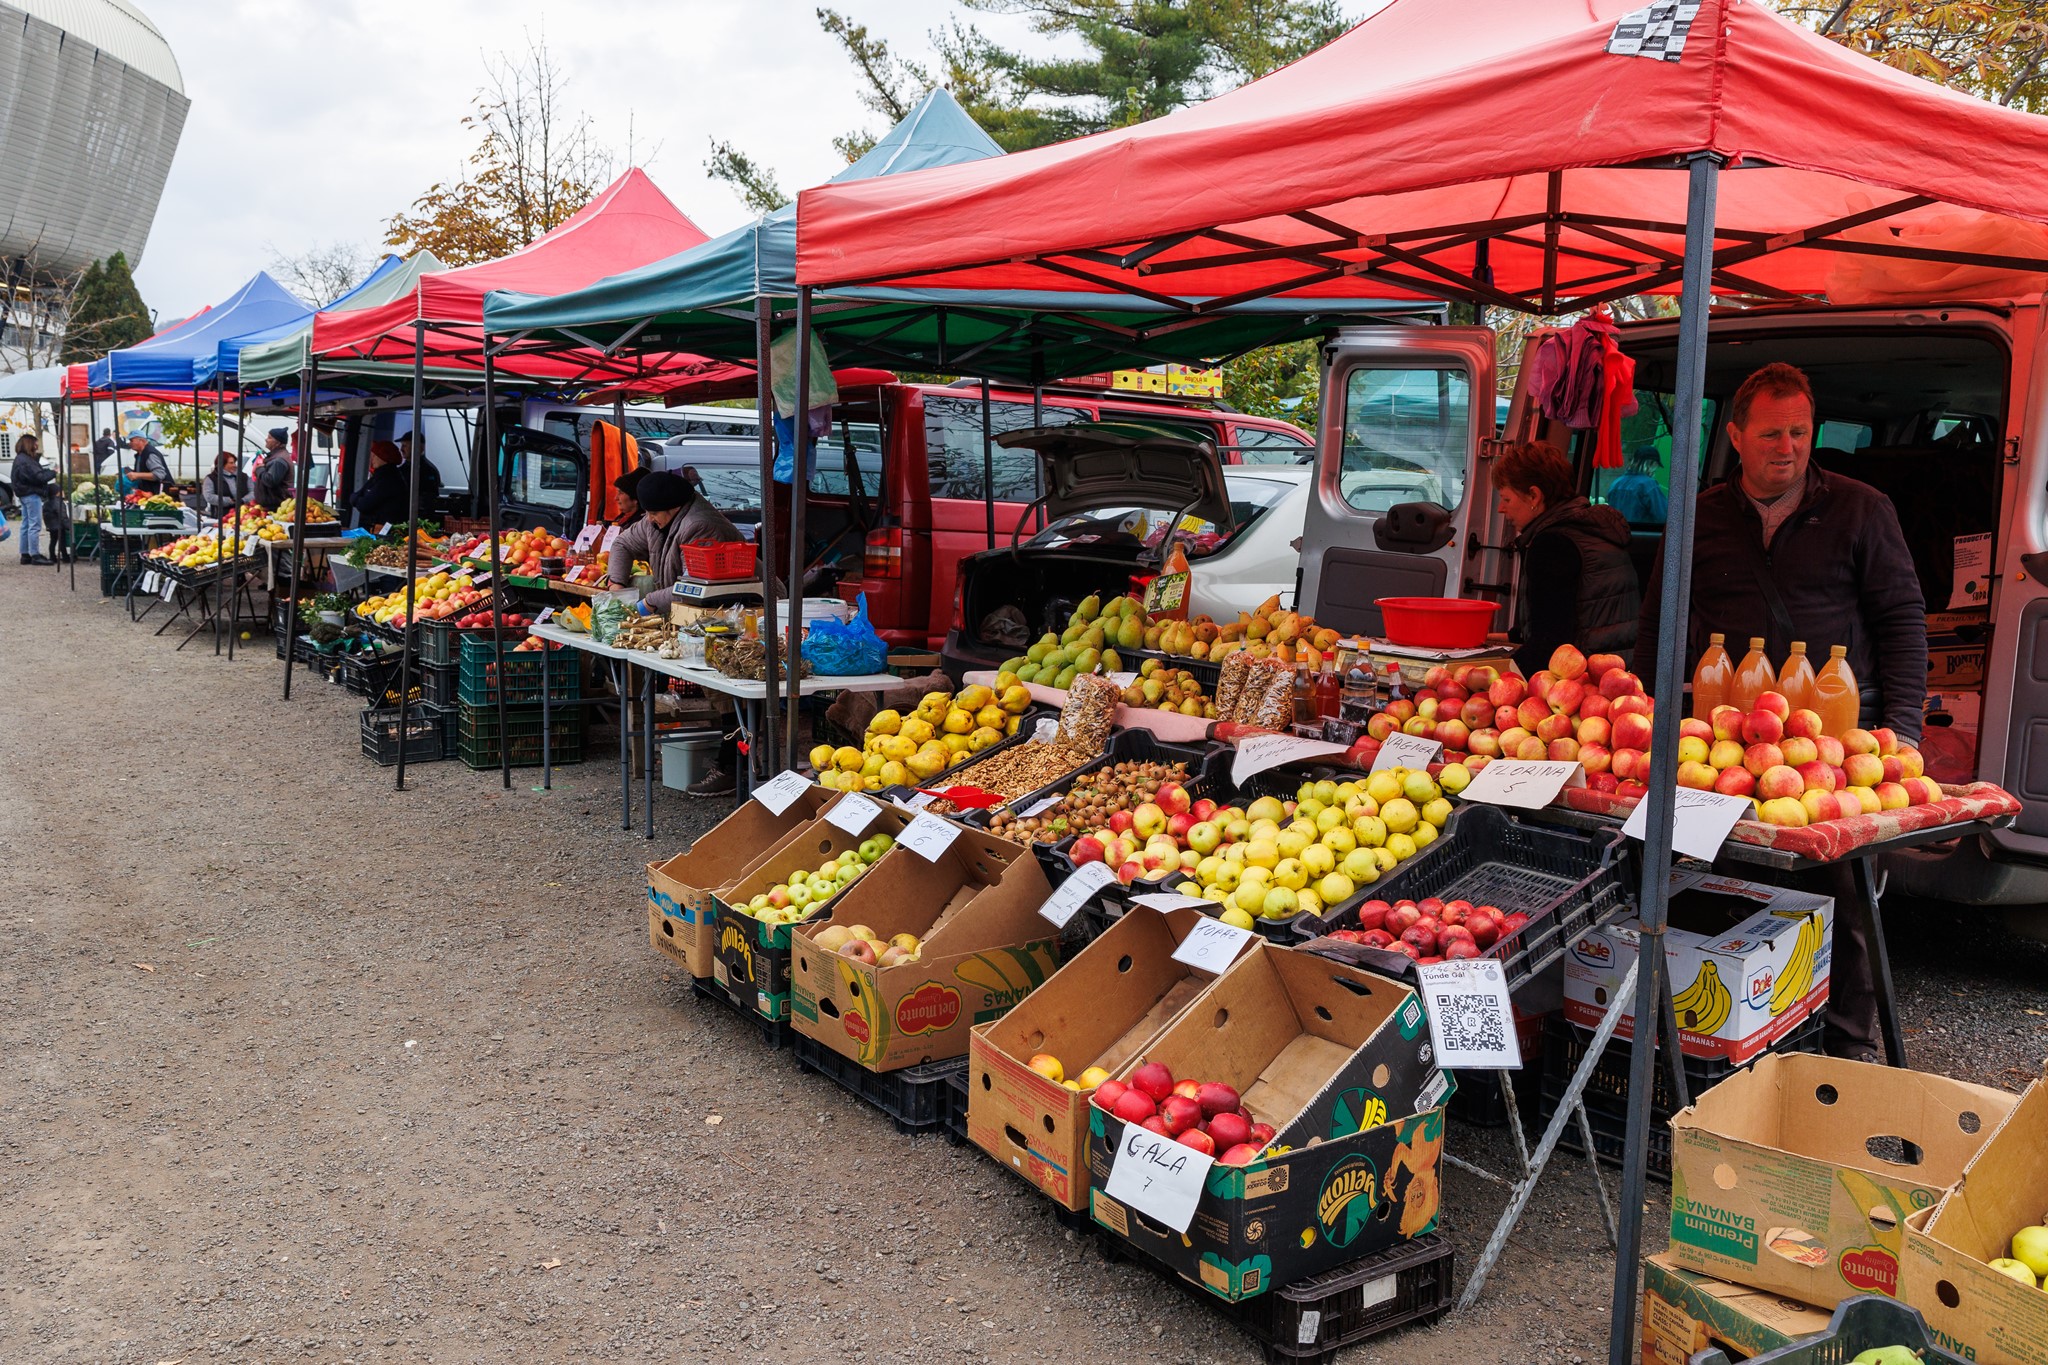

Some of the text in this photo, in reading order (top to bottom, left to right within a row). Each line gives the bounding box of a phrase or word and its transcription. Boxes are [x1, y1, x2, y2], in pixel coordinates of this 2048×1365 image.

[1955, 535, 1982, 544] PRODUCT
[1386, 735, 1434, 755] VAGNER
[1489, 764, 1565, 777] FLORINA
[1503, 781, 1527, 793] 5
[1675, 790, 1732, 807] NATHAN
[912, 816, 955, 841] KORMOS
[913, 835, 932, 846] 6
[1056, 901, 1077, 920] 5
[655, 934, 687, 964] BANANAS
[721, 926, 754, 982] yellow
[1196, 941, 1216, 956] 6
[1577, 938, 1610, 959] Dole
[1752, 972, 1772, 996] Dole
[900, 1000, 956, 1022] Del Monte
[1681, 1033, 1715, 1048] BANANAS
[1026, 1132, 1068, 1165] BANANAS
[1127, 1133, 1188, 1175] GALA
[1693, 1140, 1720, 1152] PRODUCT
[1028, 1154, 1069, 1203] Dole
[1142, 1176, 1153, 1192] 7
[1318, 1169, 1376, 1217] yellow
[1674, 1196, 1755, 1231] BANANAS
[1684, 1216, 1754, 1249] Premium
[1908, 1236, 1935, 1255] ECUADOR
[1843, 1260, 1887, 1284] Monte
[1864, 1255, 1894, 1271] Quality
[1928, 1325, 1976, 1361] BANA
